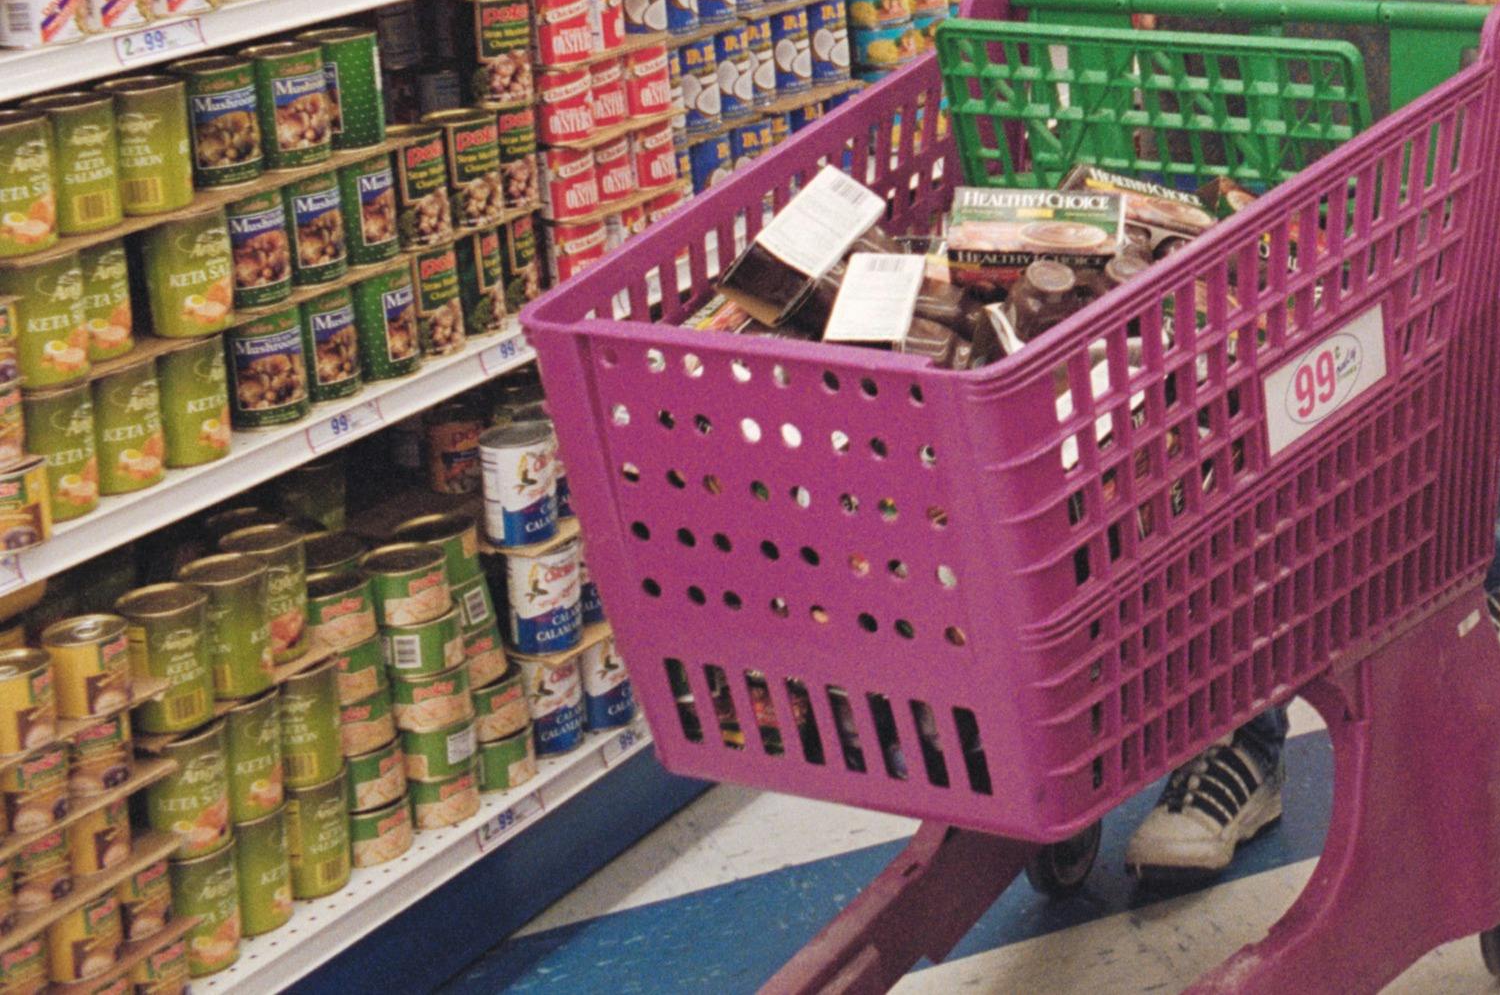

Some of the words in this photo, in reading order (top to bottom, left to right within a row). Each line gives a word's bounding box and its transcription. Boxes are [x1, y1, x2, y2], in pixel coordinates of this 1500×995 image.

[1087, 166, 1151, 193] HEALTHY
[0, 184, 30, 204] ETA
[962, 190, 1036, 210] HEALTHY
[1046, 192, 1111, 211] CHOICE
[956, 250, 1031, 266] HEALTHY
[169, 272, 206, 288] KETA
[27, 314, 71, 333] KETA
[102, 423, 144, 443] KETA
